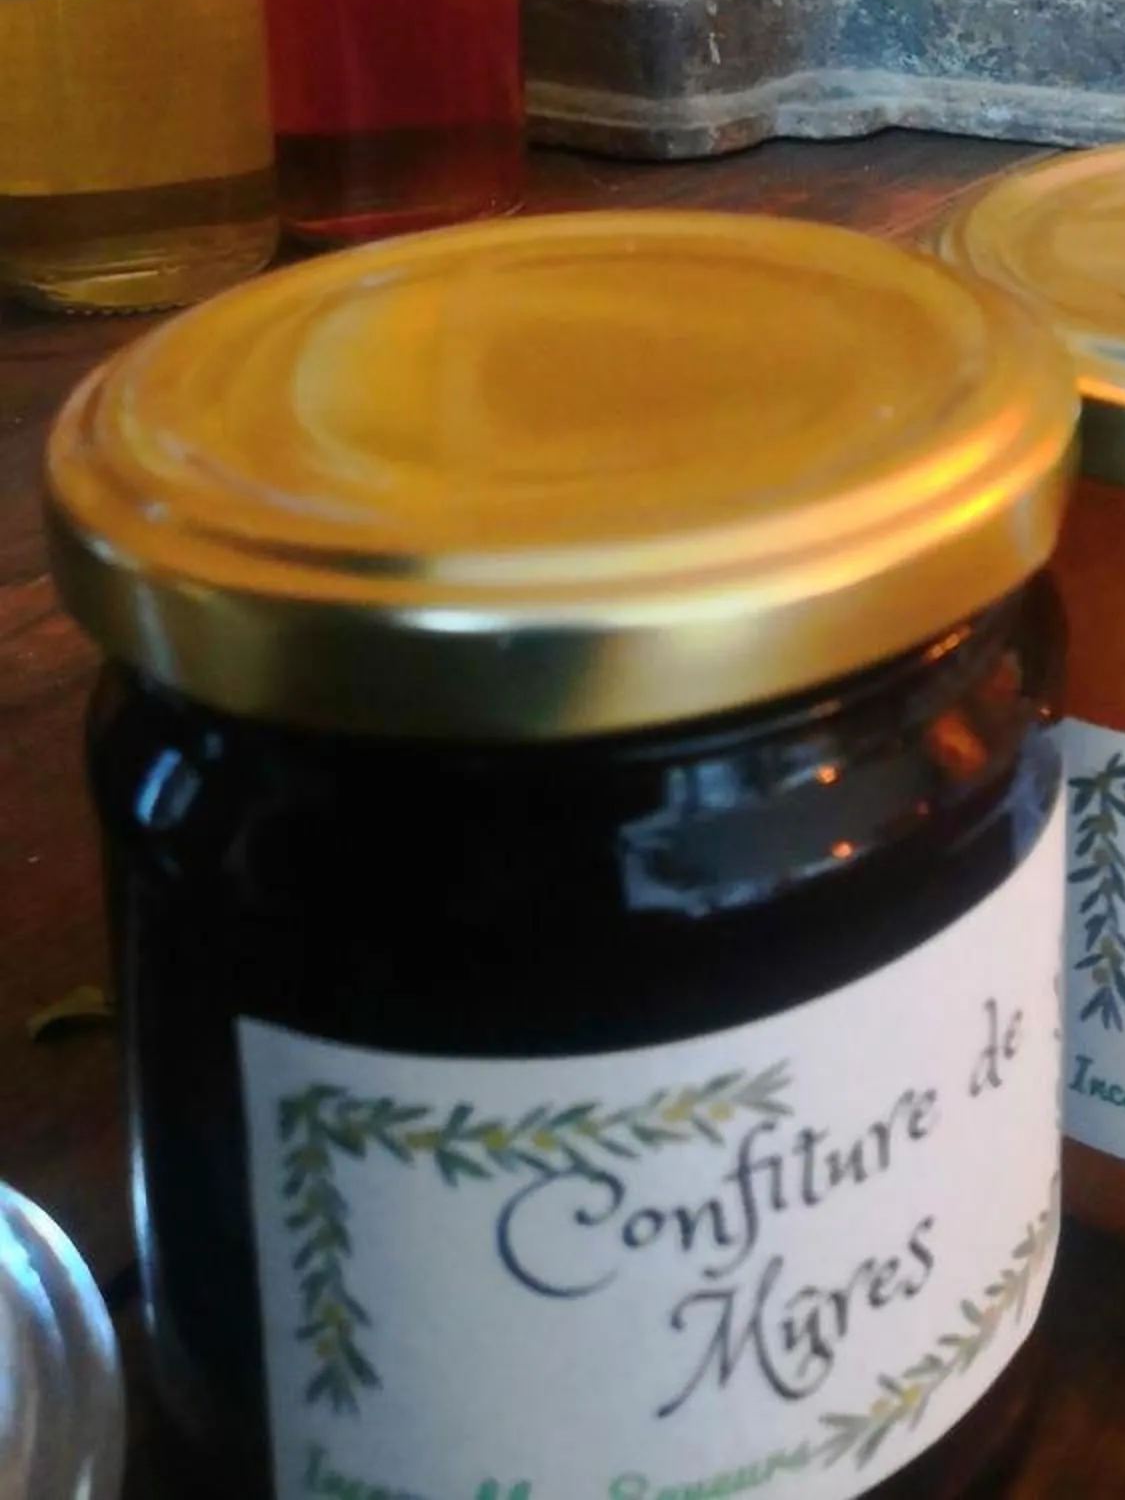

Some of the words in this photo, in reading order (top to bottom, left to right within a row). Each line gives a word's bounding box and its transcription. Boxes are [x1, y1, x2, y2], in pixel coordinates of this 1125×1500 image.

[496, 1085, 938, 1299] Confiture
[968, 997, 1023, 1100] de
[656, 1214, 936, 1420] Mûres
